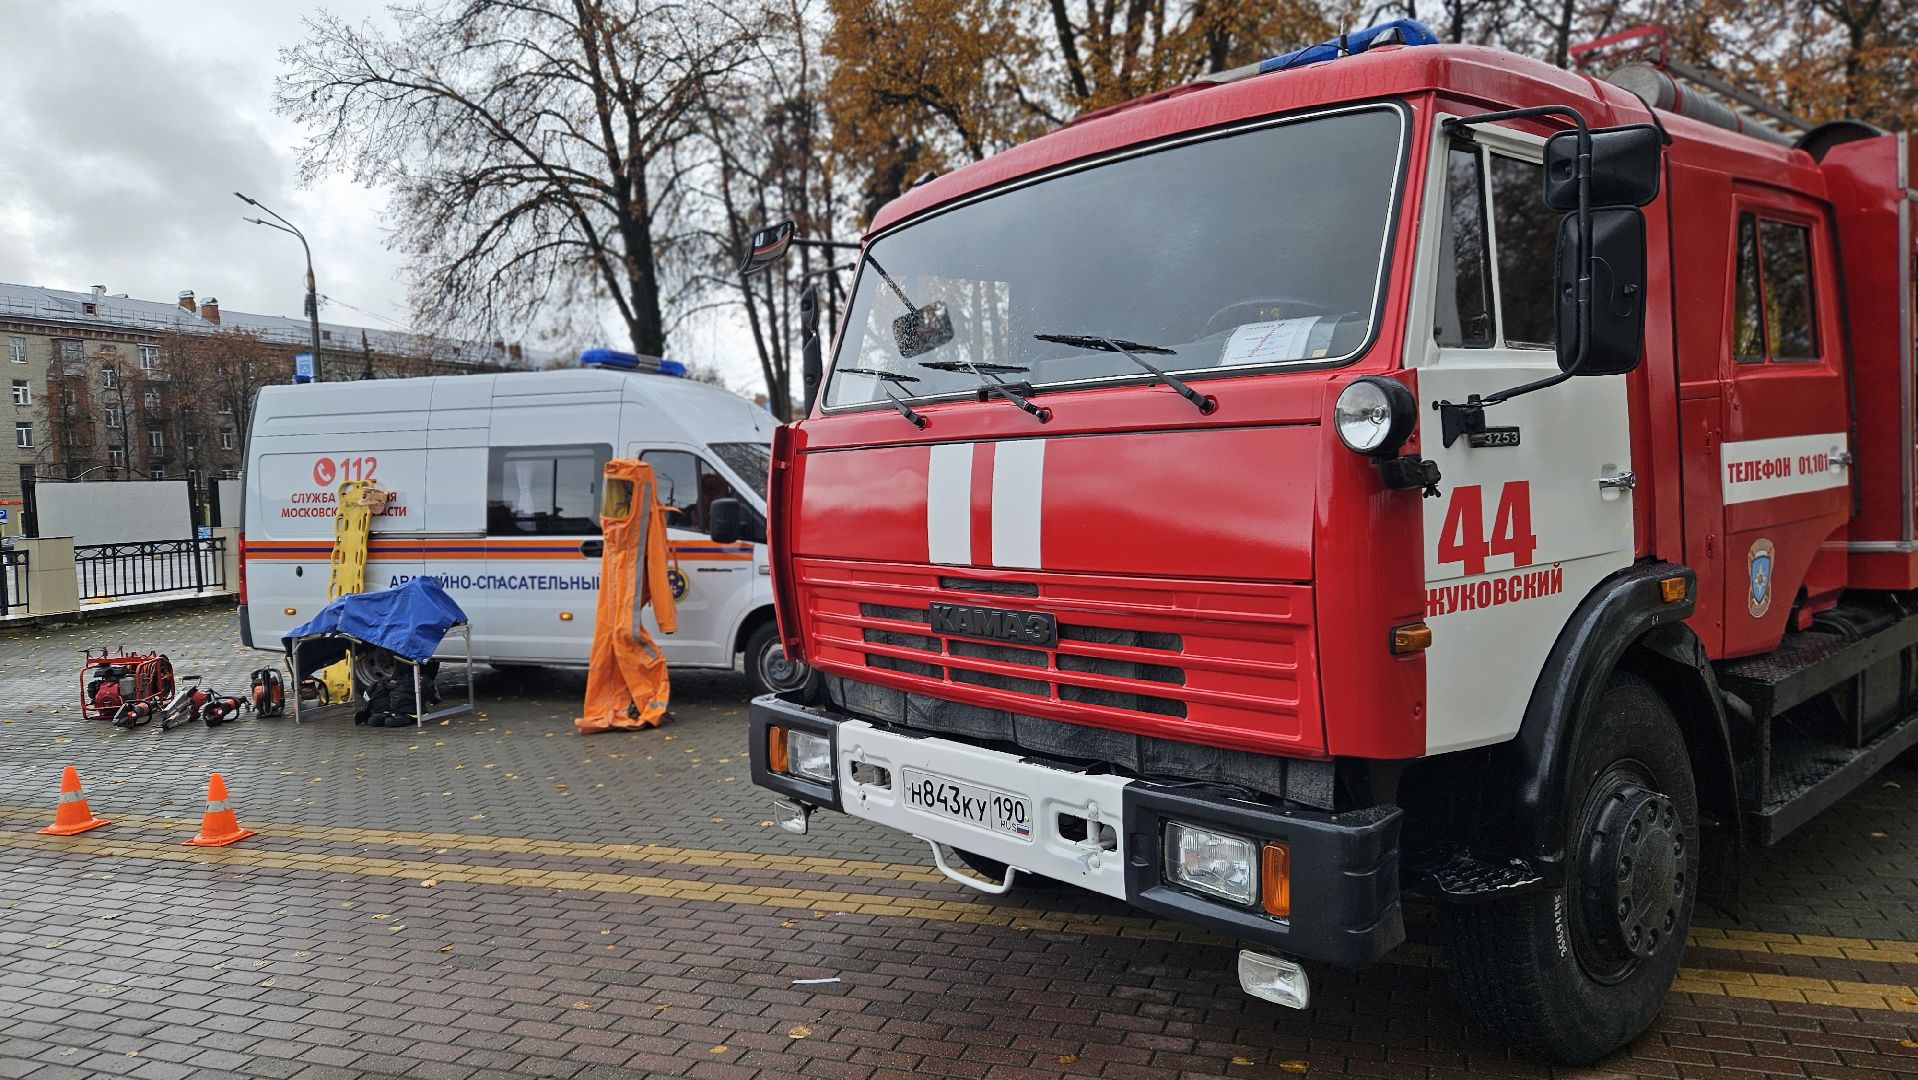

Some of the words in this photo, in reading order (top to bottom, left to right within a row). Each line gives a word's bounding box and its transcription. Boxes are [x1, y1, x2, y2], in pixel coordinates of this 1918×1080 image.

[1485, 432, 1519, 444] 3253
[340, 456, 377, 483] 112
[1727, 457, 1791, 483] ТЕЛЕФОН
[291, 492, 336, 504] СЛУЖБА
[281, 507, 338, 518] МОСКОВСК
[1437, 480, 1537, 576] 44
[1424, 562, 1563, 618] ЖУКОВСКИЙ
[931, 604, 1052, 644] КАМАЗ
[993, 796, 1025, 823] 190
[1000, 820, 1017, 832] RUS
